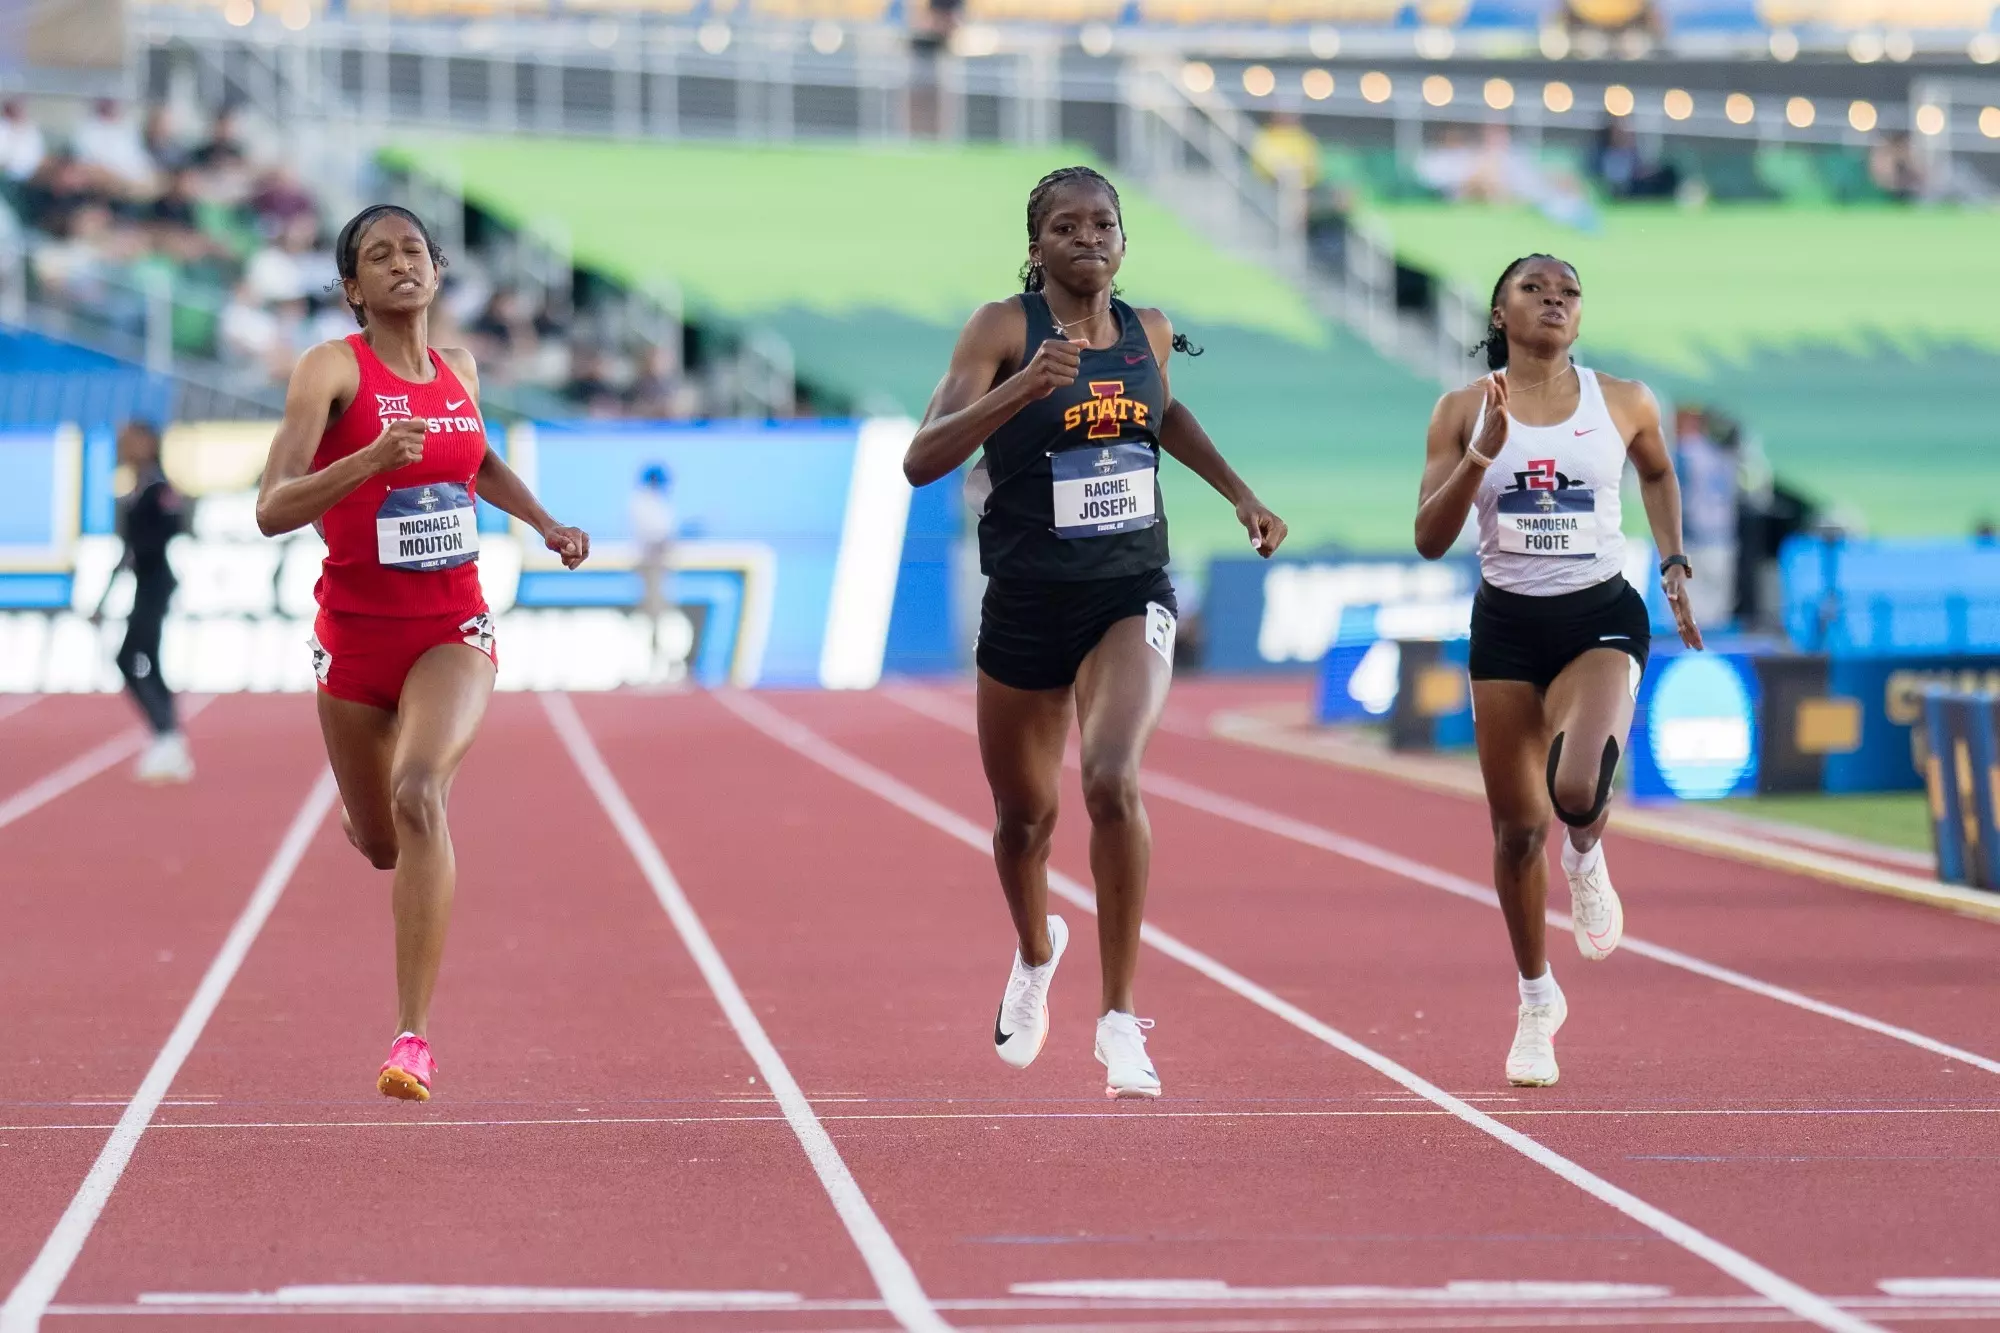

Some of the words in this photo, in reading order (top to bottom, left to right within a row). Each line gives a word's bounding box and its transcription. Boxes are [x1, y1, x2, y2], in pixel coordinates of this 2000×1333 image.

[1064, 398, 1148, 431] STATE
[1085, 479, 1130, 497] RACHEL
[1079, 496, 1137, 520] JOSEPH
[399, 515, 460, 536] MICHAELA
[1517, 518, 1578, 532] SHAQUENA
[399, 532, 463, 557] MOUTON
[1525, 535, 1569, 550] FOOTE
